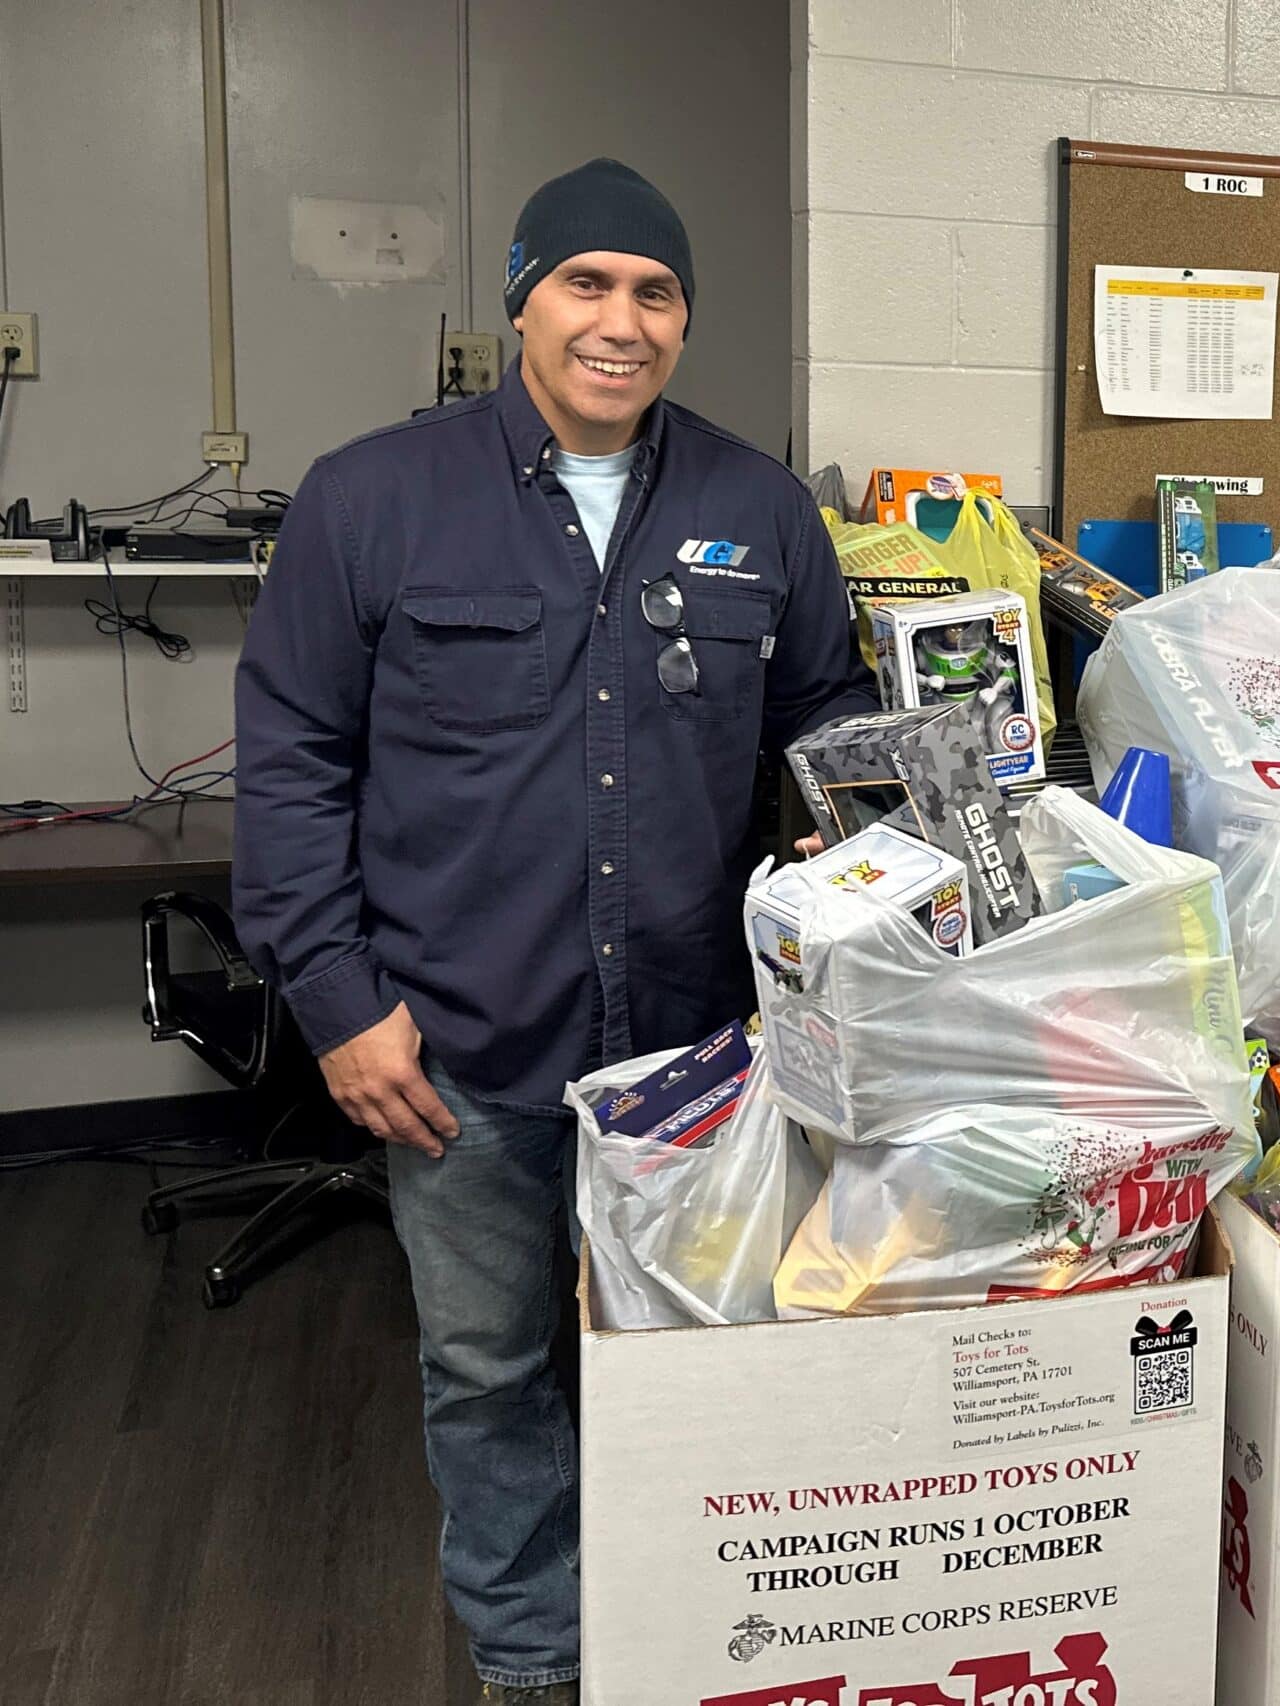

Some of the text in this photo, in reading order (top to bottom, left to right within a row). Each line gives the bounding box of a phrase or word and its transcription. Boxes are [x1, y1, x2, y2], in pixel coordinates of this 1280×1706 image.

[1203, 177, 1248, 193] 1 ROC
[676, 538, 750, 567] UGI
[690, 566, 717, 576] Energy
[879, 580, 962, 594] GENERAL
[994, 609, 1021, 624] TOY
[1003, 630, 1016, 642] 4
[1012, 725, 1024, 735] RC
[990, 755, 1029, 770] LIGHTYEAR
[795, 753, 831, 816] GHOST
[954, 810, 1002, 918] REMOTE CONTROL HELICOPTER
[965, 802, 1020, 907] GHOST
[932, 878, 963, 903] TOY
[1147, 1235, 1170, 1248] FOR
[1141, 1298, 1188, 1312] Donation
[952, 1328, 1032, 1346] Mail Checks to:
[1138, 1332, 1190, 1350] SCAN ME
[1237, 1312, 1268, 1356] ONLY
[953, 1344, 1029, 1364] Toys for Tots
[953, 1358, 1040, 1379] 507 Cemetery St.
[953, 1366, 1073, 1393] Williamsport, PA 17701
[953, 1390, 1040, 1412] Visit our website:
[953, 1392, 1116, 1426] Williamsport-PA.ToysforTots.org
[953, 1436, 992, 1450] Donated
[994, 1432, 1005, 1445] by
[1007, 1428, 1036, 1442] Labels
[1038, 1426, 1049, 1438] by
[1087, 1417, 1104, 1429] Inc.
[703, 1450, 1142, 1518] NEW, UNWRAPPED TOYS ONLY
[717, 1497, 1132, 1562] CAMPAIGN RUNS 1 OCTOBER
[747, 1533, 1104, 1593] THROUGH DECEMBER
[779, 1585, 1120, 1647] MARINE CORPS RESERVE
